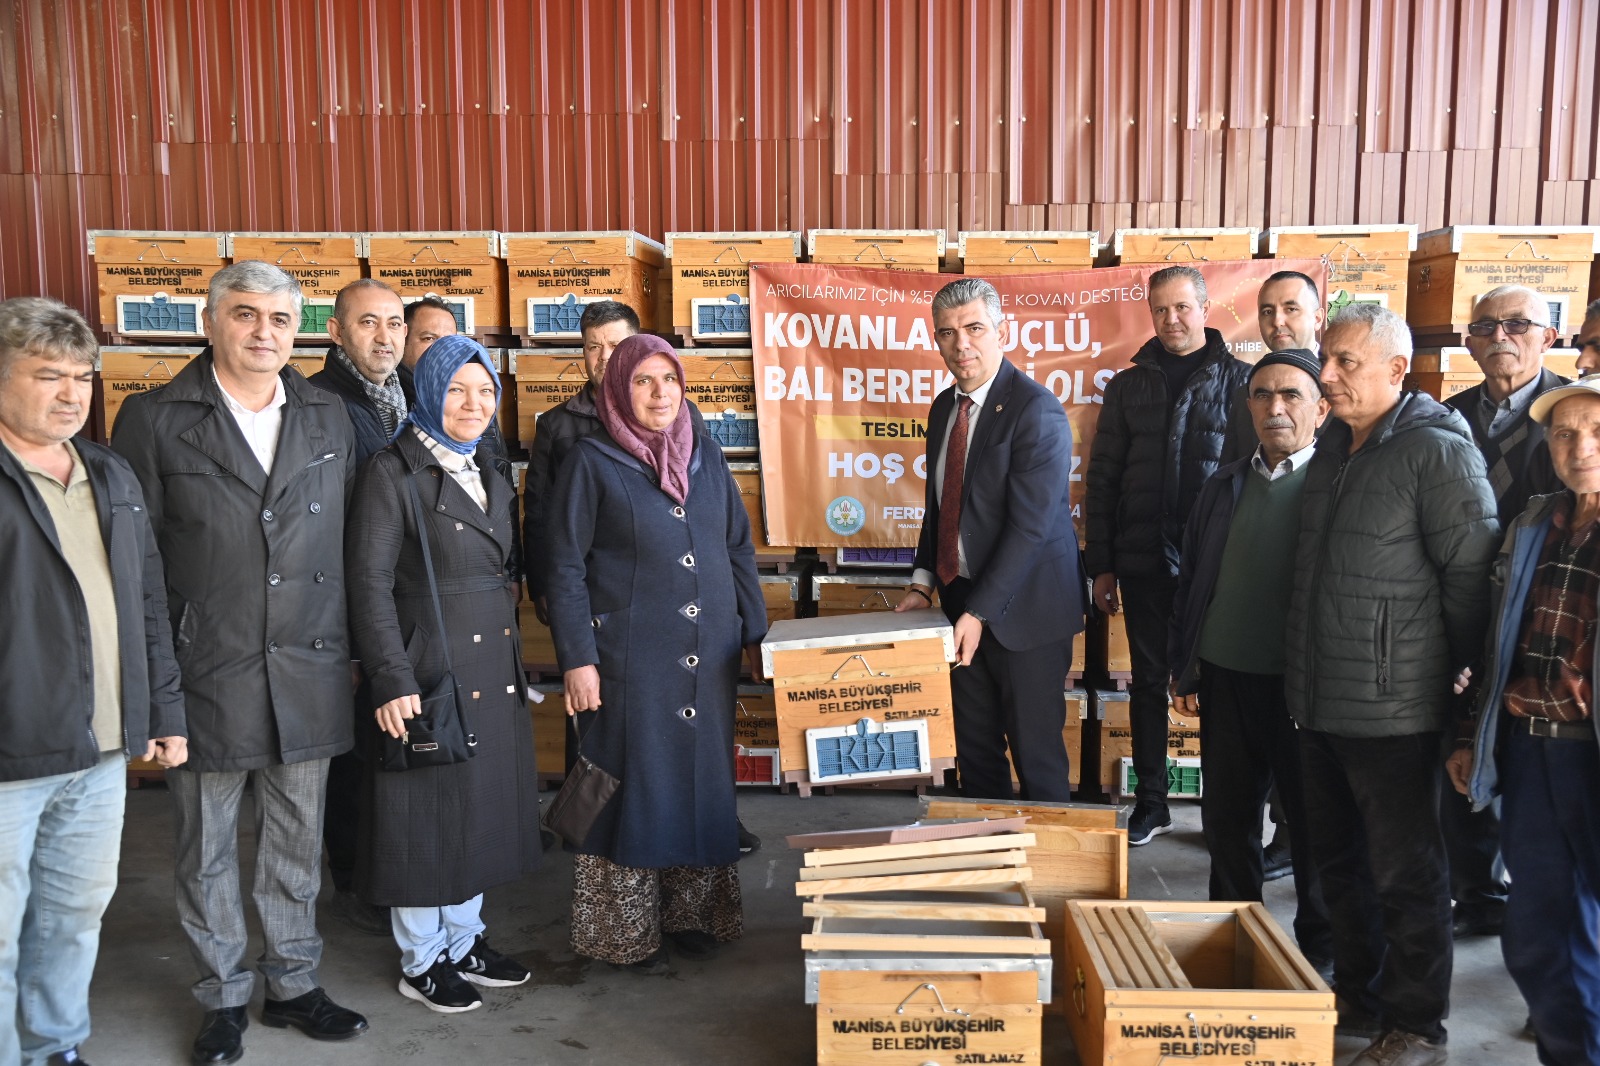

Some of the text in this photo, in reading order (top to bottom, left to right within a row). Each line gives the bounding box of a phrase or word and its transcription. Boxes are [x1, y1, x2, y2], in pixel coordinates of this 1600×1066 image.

[106, 265, 203, 279] MANİSA BÜYÜKŞEHİR
[379, 268, 473, 280] MANİSA BÜYÜKŞEHİR
[517, 267, 611, 279] MANİSA BÜYÜKŞEHİR
[681, 267, 750, 278] MANİSA BÜYÜK
[1465, 263, 1502, 274] MANİSA
[128, 275, 182, 286] BELEDİYESİ
[400, 277, 452, 288] BELEDİYESİ
[537, 277, 590, 288] BELEDİYESİ
[1486, 273, 1544, 284] BELEDİYESİ
[175, 287, 209, 295] SATILAMA
[765, 284, 867, 302] ARICILARIMIZ
[871, 285, 906, 307] İÇİN
[1015, 292, 1075, 307] KOVAN
[1080, 283, 1149, 305] DESTEĞİ
[763, 312, 939, 351] KOVANLA
[1235, 340, 1262, 353] HİBE
[112, 381, 148, 391] MANİSA
[525, 383, 560, 393] MANİSA
[685, 384, 711, 393] ANİSA
[763, 365, 833, 402] BAL
[697, 393, 751, 403] BELEDİYESİ
[828, 452, 905, 484] HOŞ
[787, 681, 922, 702] MANİSA BÜYÜKŞEHİR
[819, 696, 893, 714] BELEDİYESİ
[884, 708, 941, 721] SATILAMAZ
[833, 1016, 1005, 1035] MANİSA BÜYÜKŞEHİR
[1121, 1022, 1296, 1042] MANİSA BÜYÜKŞEHİR
[872, 1034, 967, 1050] BELEDİYESİ
[1160, 1041, 1256, 1056] BELEDİYESİ
[955, 1053, 1025, 1064] SATILAMAZ
